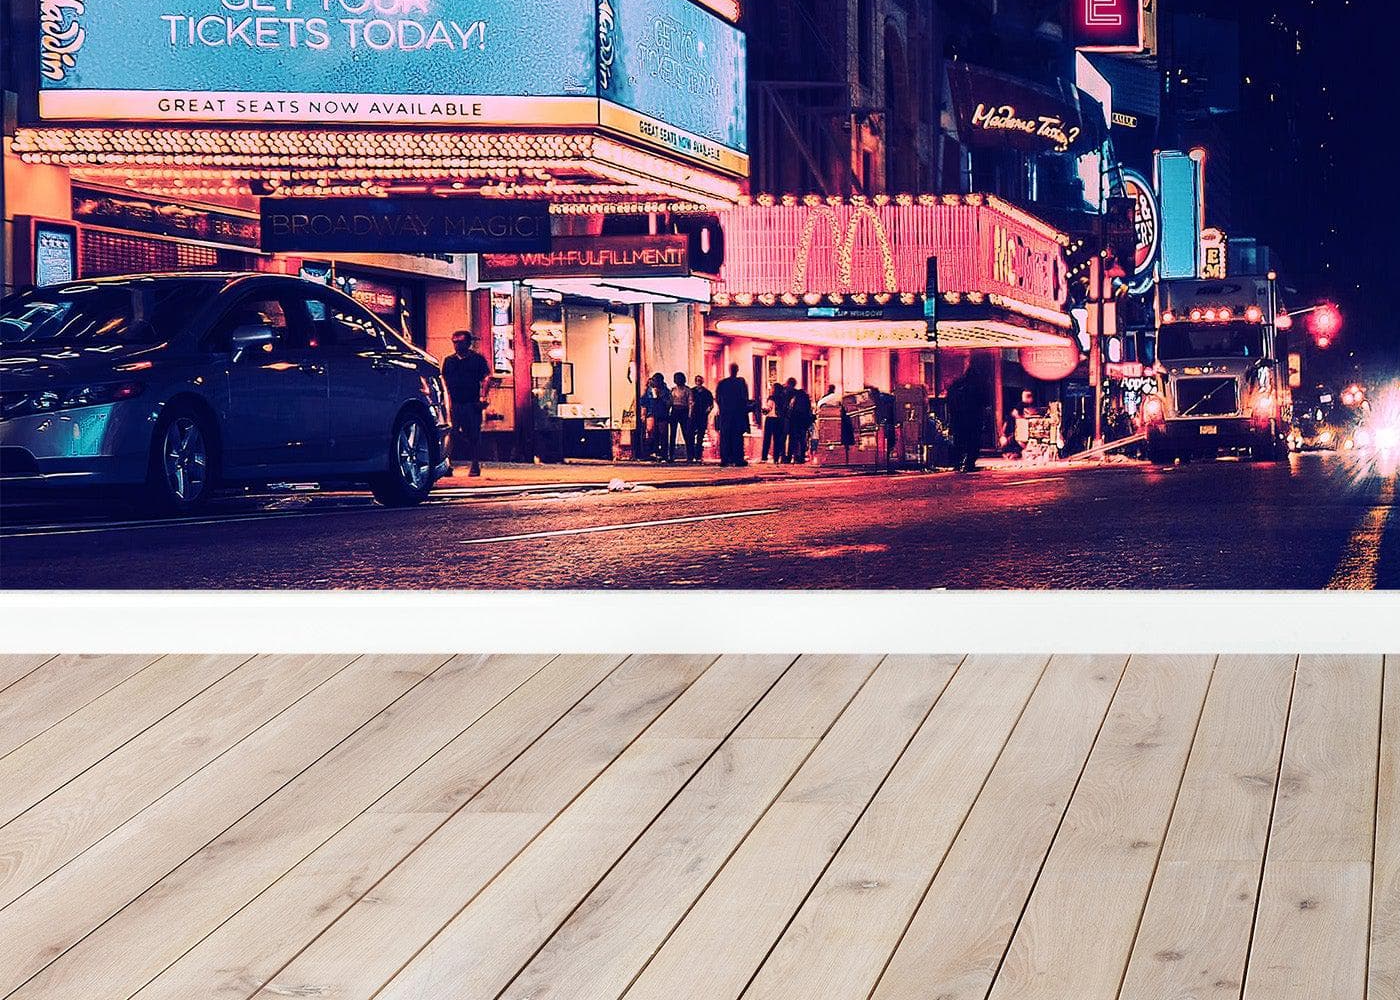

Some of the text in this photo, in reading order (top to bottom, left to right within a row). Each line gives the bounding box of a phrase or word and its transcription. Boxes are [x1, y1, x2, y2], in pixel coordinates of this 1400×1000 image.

[160, 13, 487, 50] TICKETS TODAY!
[158, 98, 483, 116] GREAT SEATS NOW AVAILABLE
[971, 103, 1036, 133] Madame
[639, 120, 659, 137] GREAT
[660, 127, 677, 145] SEATS
